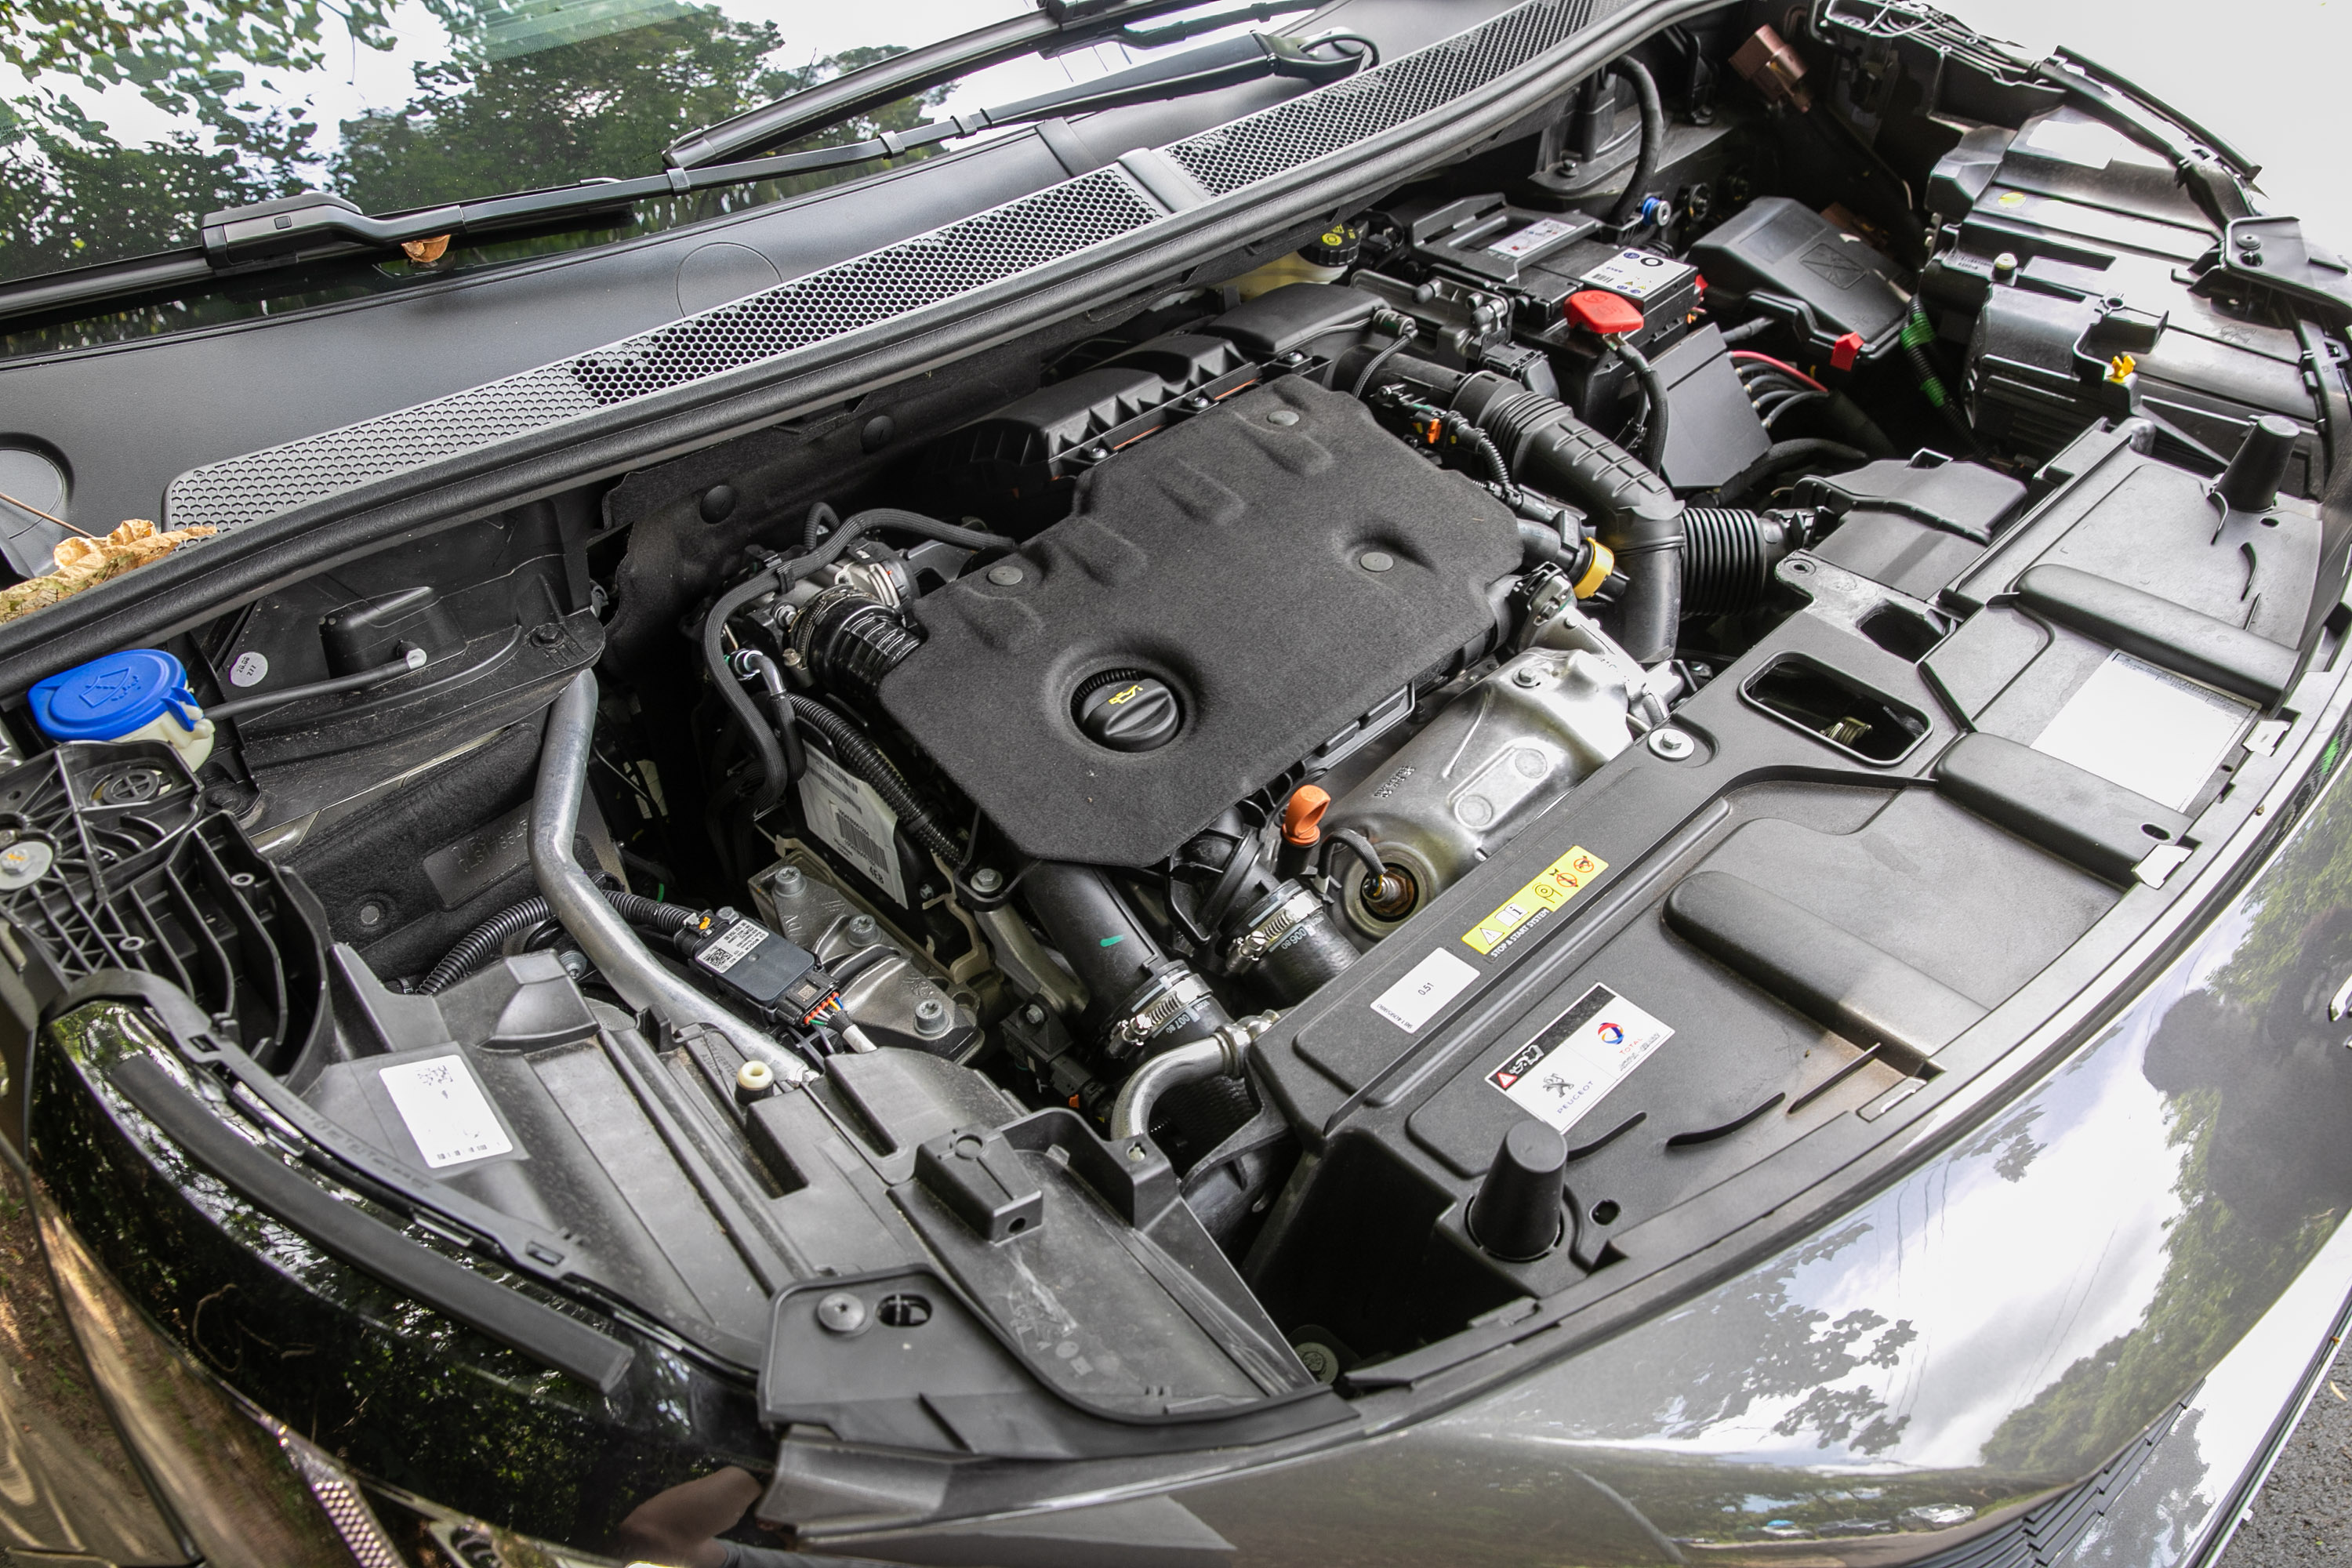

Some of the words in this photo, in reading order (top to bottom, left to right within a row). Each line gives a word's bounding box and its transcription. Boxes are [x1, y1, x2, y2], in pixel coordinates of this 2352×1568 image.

[1490, 942, 1508, 958] STOP
[1510, 924, 1530, 942] START
[1526, 908, 1551, 928] SYSTEM
[1619, 1037, 1643, 1055] TOTAL
[1557, 1080, 1594, 1114] PEUGEOT
